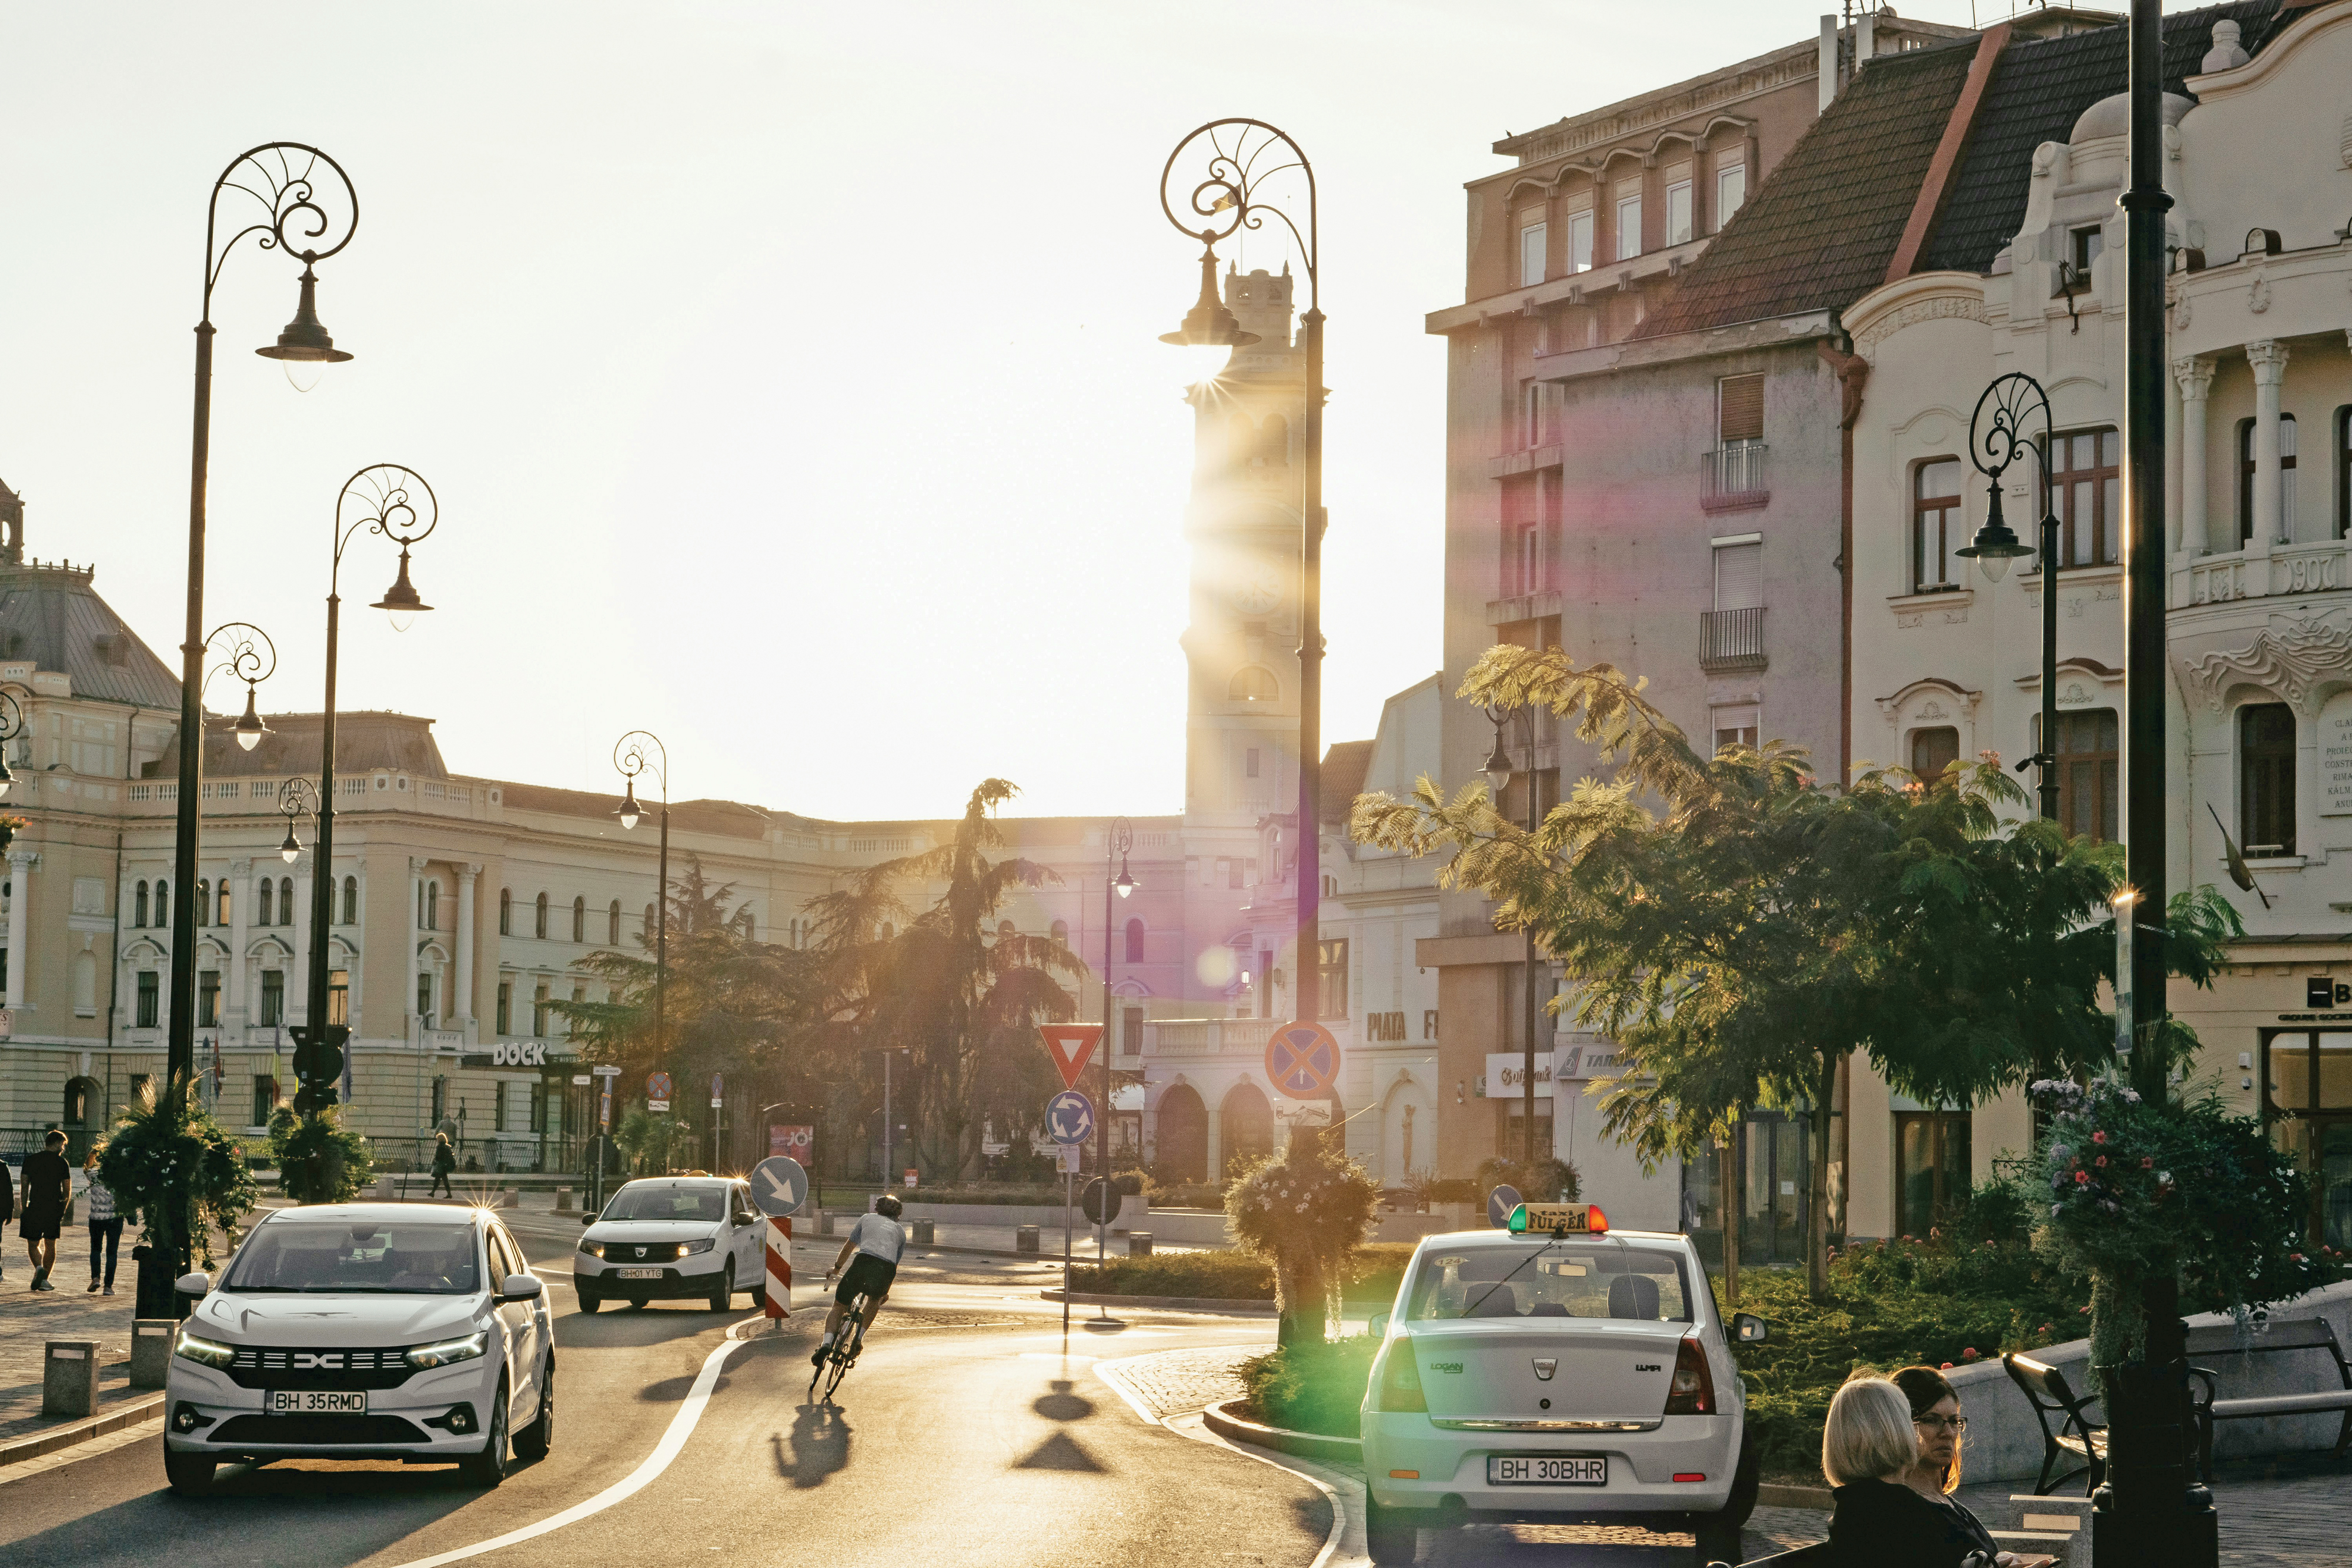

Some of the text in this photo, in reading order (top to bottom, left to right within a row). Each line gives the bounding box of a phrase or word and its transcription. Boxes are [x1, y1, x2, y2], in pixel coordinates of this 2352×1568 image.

[2328, 785, 2352, 794] KÁLM
[493, 1043, 546, 1065] DOCK
[1586, 1054, 1637, 1067] TARM
[1529, 1211, 1586, 1229] FULGER
[276, 1393, 363, 1410] BH 35RMD
[1501, 1460, 1603, 1479] BH 30BHR
